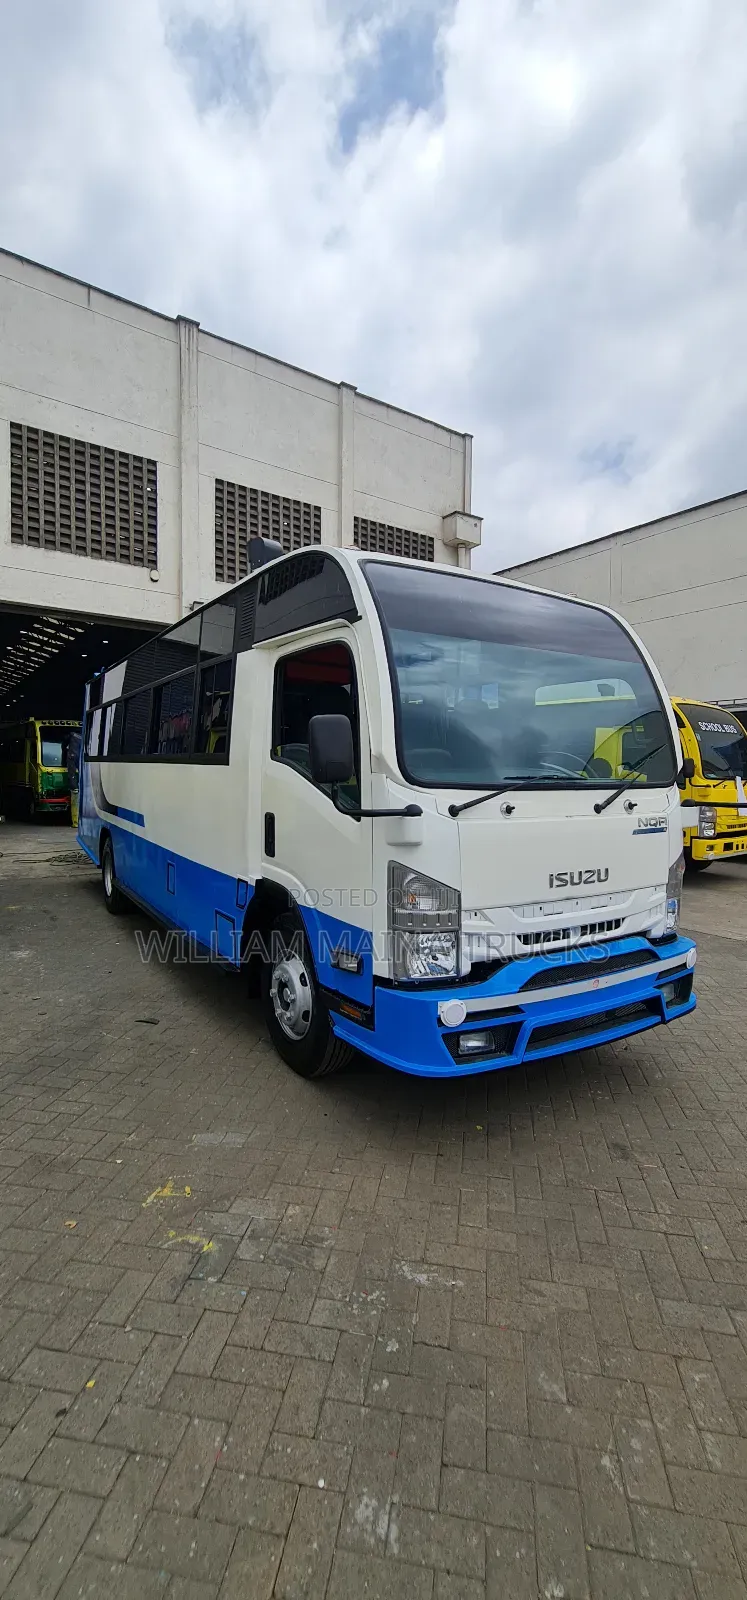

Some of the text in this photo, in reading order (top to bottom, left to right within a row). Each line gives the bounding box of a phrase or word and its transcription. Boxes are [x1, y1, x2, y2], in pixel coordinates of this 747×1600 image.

[698, 721, 738, 734] SCHOOL BUS
[548, 868, 609, 889] ISUZU
